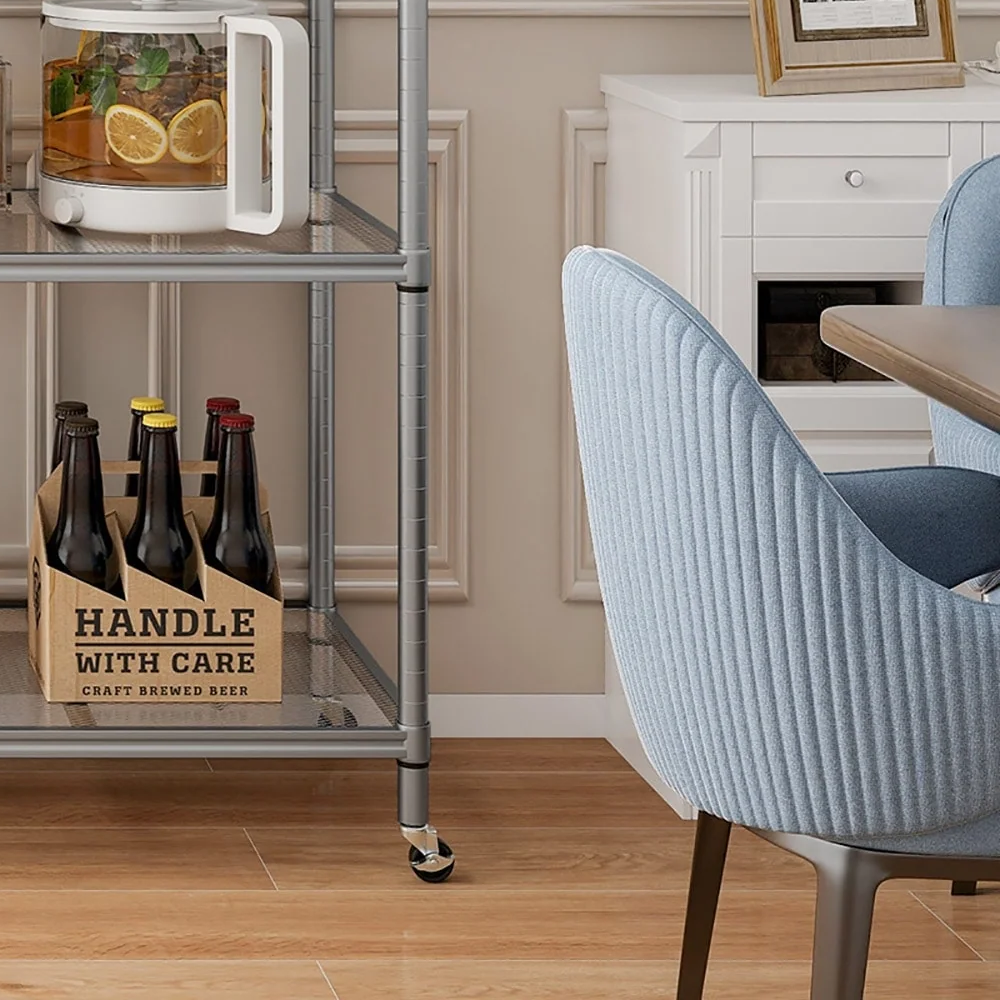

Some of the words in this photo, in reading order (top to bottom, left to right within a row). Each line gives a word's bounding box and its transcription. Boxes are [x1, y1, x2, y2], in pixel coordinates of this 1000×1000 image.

[75, 609, 255, 637] HANDLE
[75, 653, 160, 673] WITH
[171, 653, 255, 673] CARE
[82, 686, 132, 696] CRAFT
[139, 686, 202, 696] BREWED
[209, 686, 248, 696] BEER
